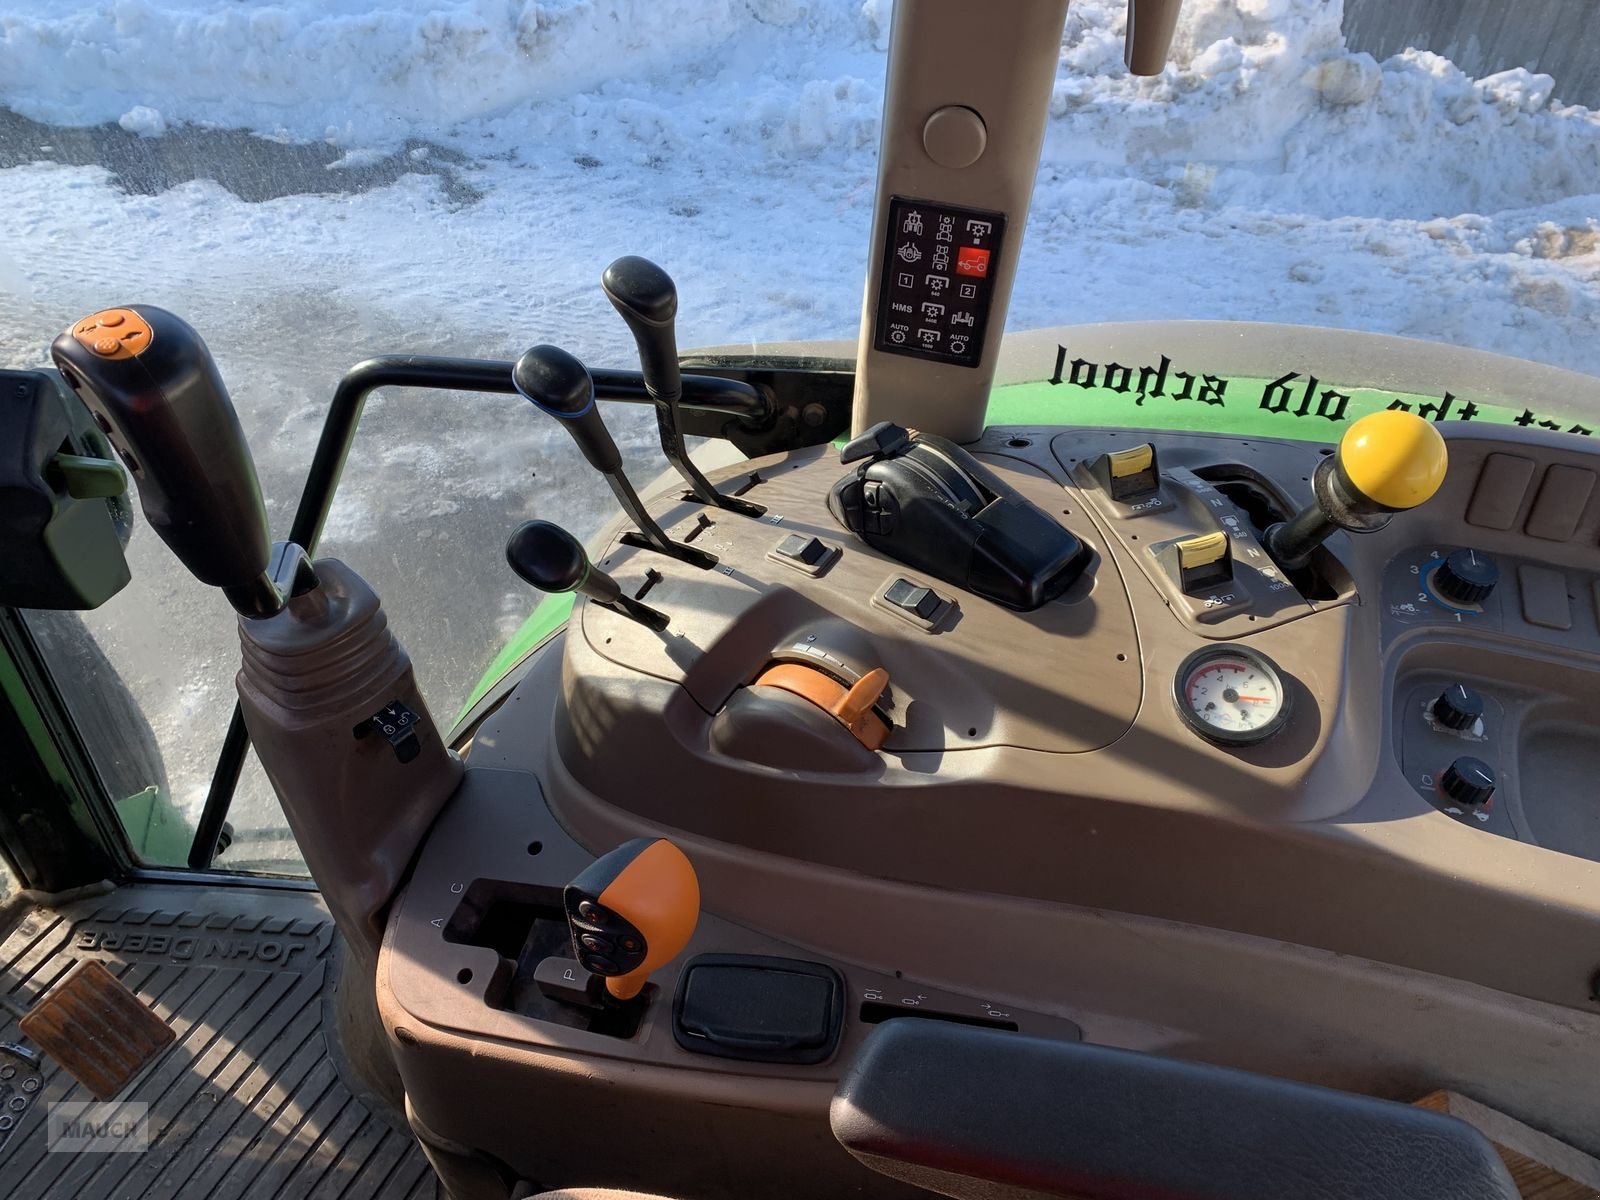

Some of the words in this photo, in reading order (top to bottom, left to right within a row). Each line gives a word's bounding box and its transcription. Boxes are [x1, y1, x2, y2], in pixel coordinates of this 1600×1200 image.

[964, 287, 971, 295] 2
[891, 302, 913, 313] HMS
[890, 322, 909, 331] AUTO
[950, 334, 969, 342] AUTO
[1246, 547, 1260, 558] N
[1430, 550, 1440, 559] 4
[1410, 565, 1420, 575] 3
[1418, 592, 1428, 602] 2
[1454, 612, 1462, 622] 1
[1242, 681, 1249, 689] 6
[1200, 687, 1208, 695] 2
[450, 882, 464, 895] C
[430, 918, 443, 928] A
[77, 930, 200, 961] DEERE
[204, 938, 305, 967] JOHN
[563, 968, 576, 982] P
